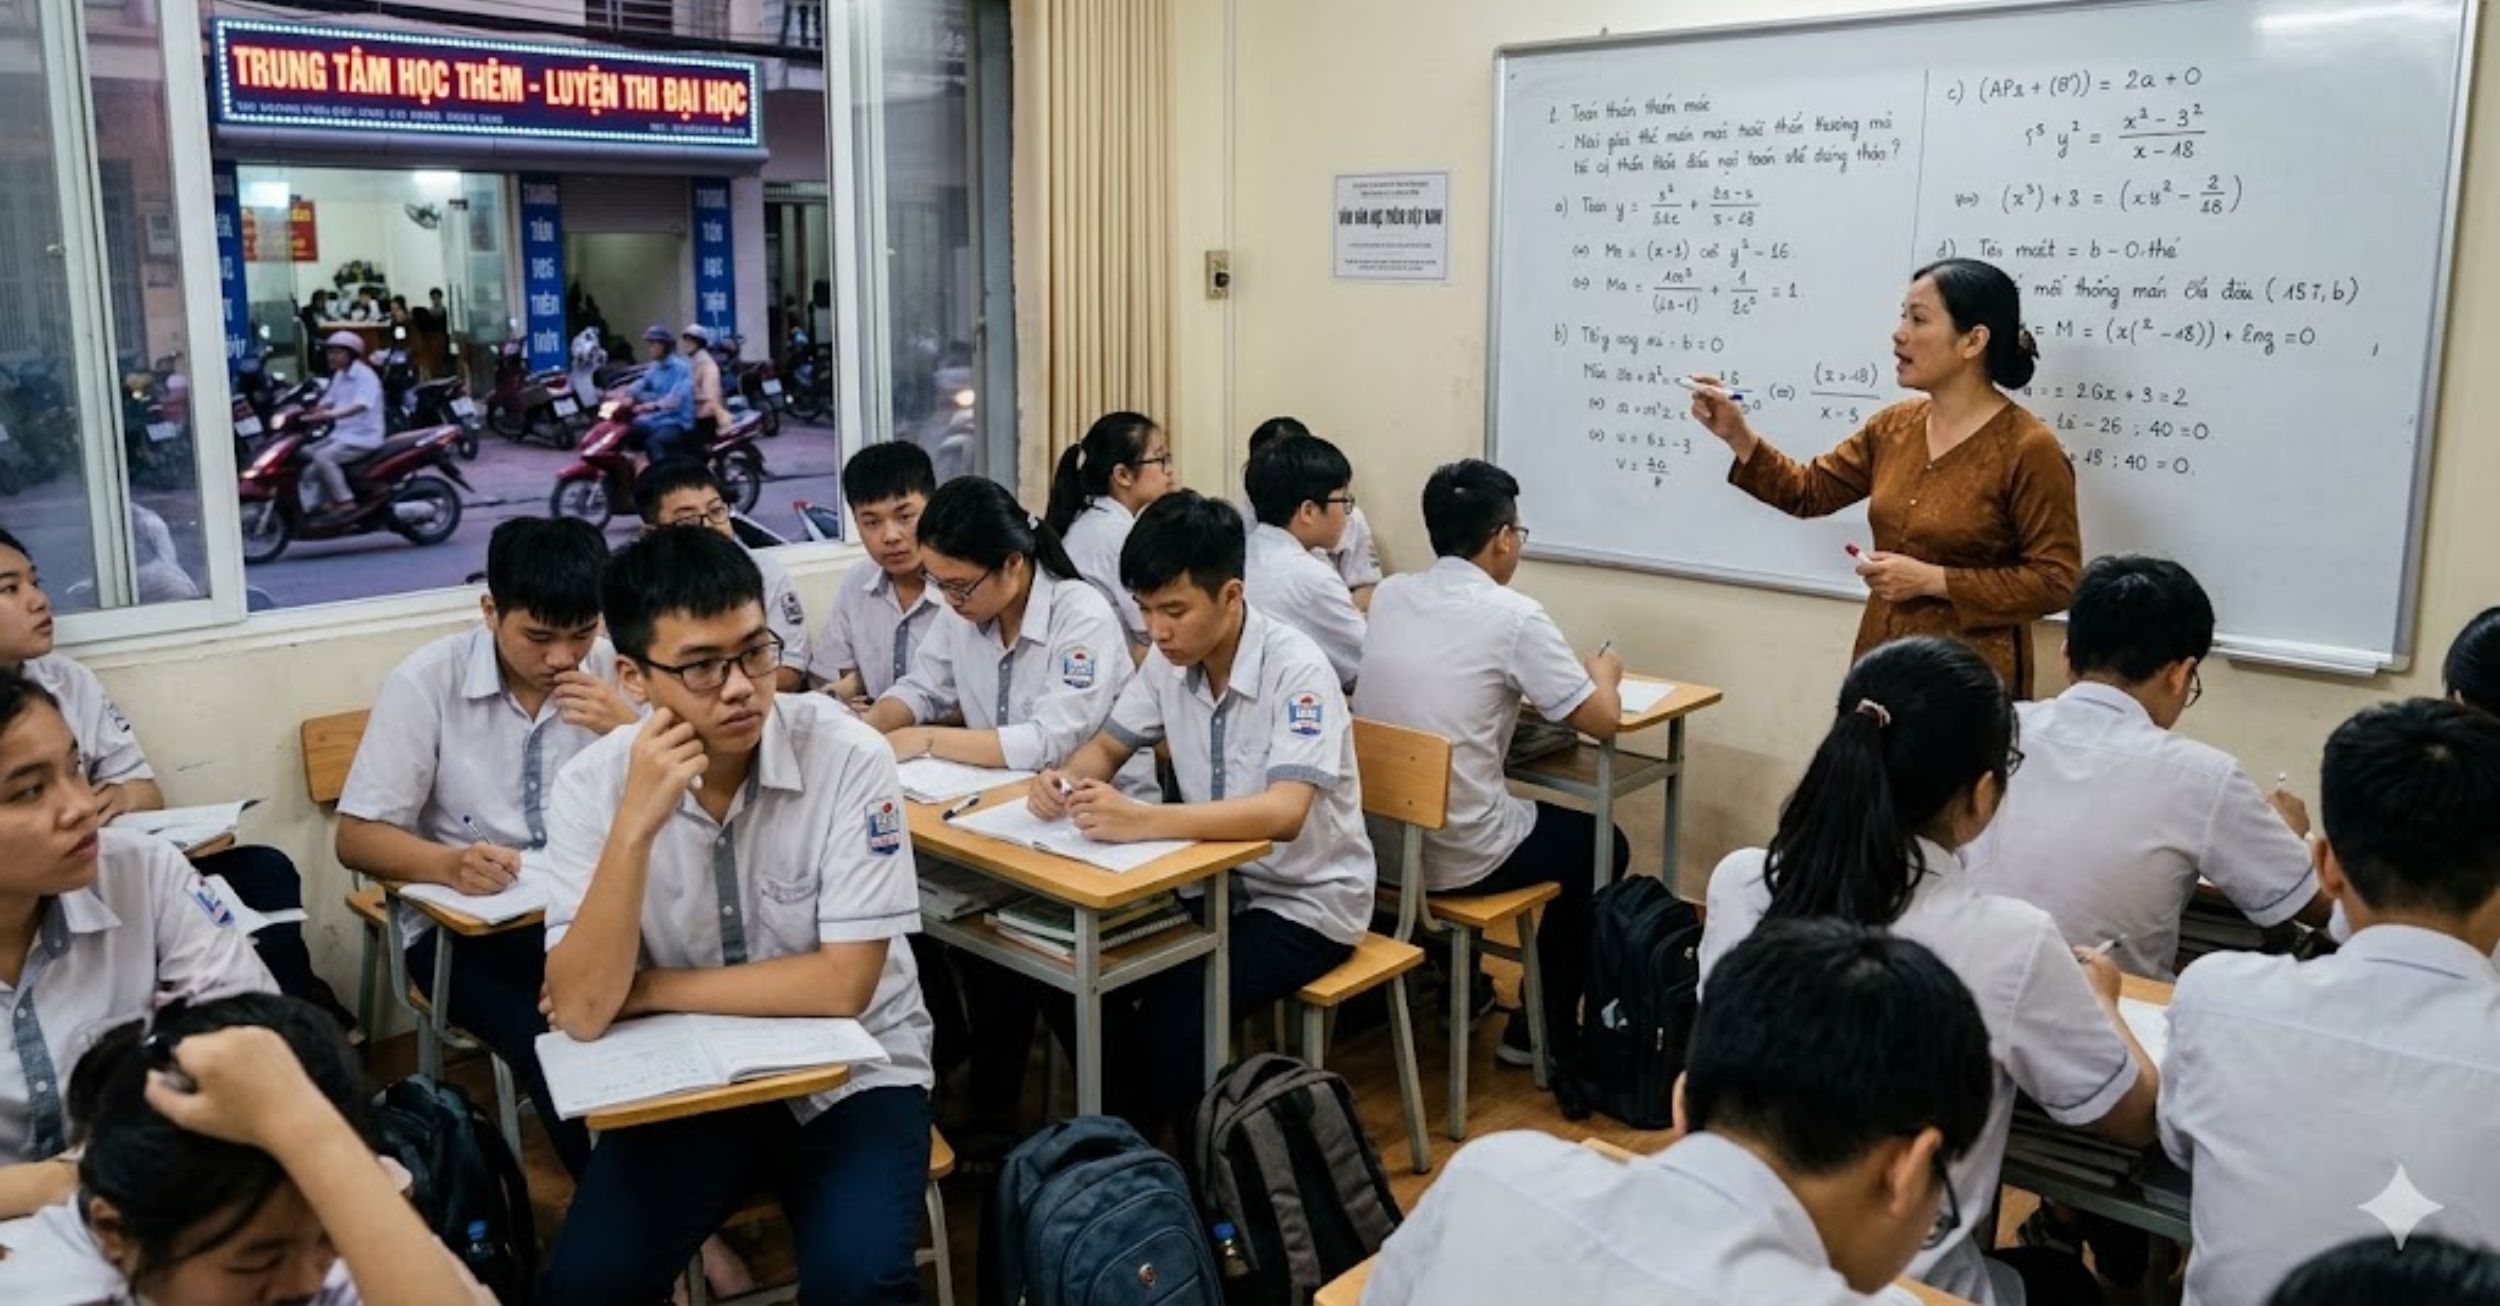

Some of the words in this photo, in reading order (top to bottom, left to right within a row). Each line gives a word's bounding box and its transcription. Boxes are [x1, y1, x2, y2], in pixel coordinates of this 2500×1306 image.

[232, 45, 328, 91] TRUNG
[332, 44, 393, 95] TÂM
[397, 57, 450, 105] HỌC
[454, 57, 524, 102] THÊM
[545, 64, 618, 116] LUYỆN
[622, 74, 658, 111] THI
[663, 76, 699, 121] ĐẠI
[704, 79, 748, 123] HỌC
[2124, 69, 2156, 89] 2a
